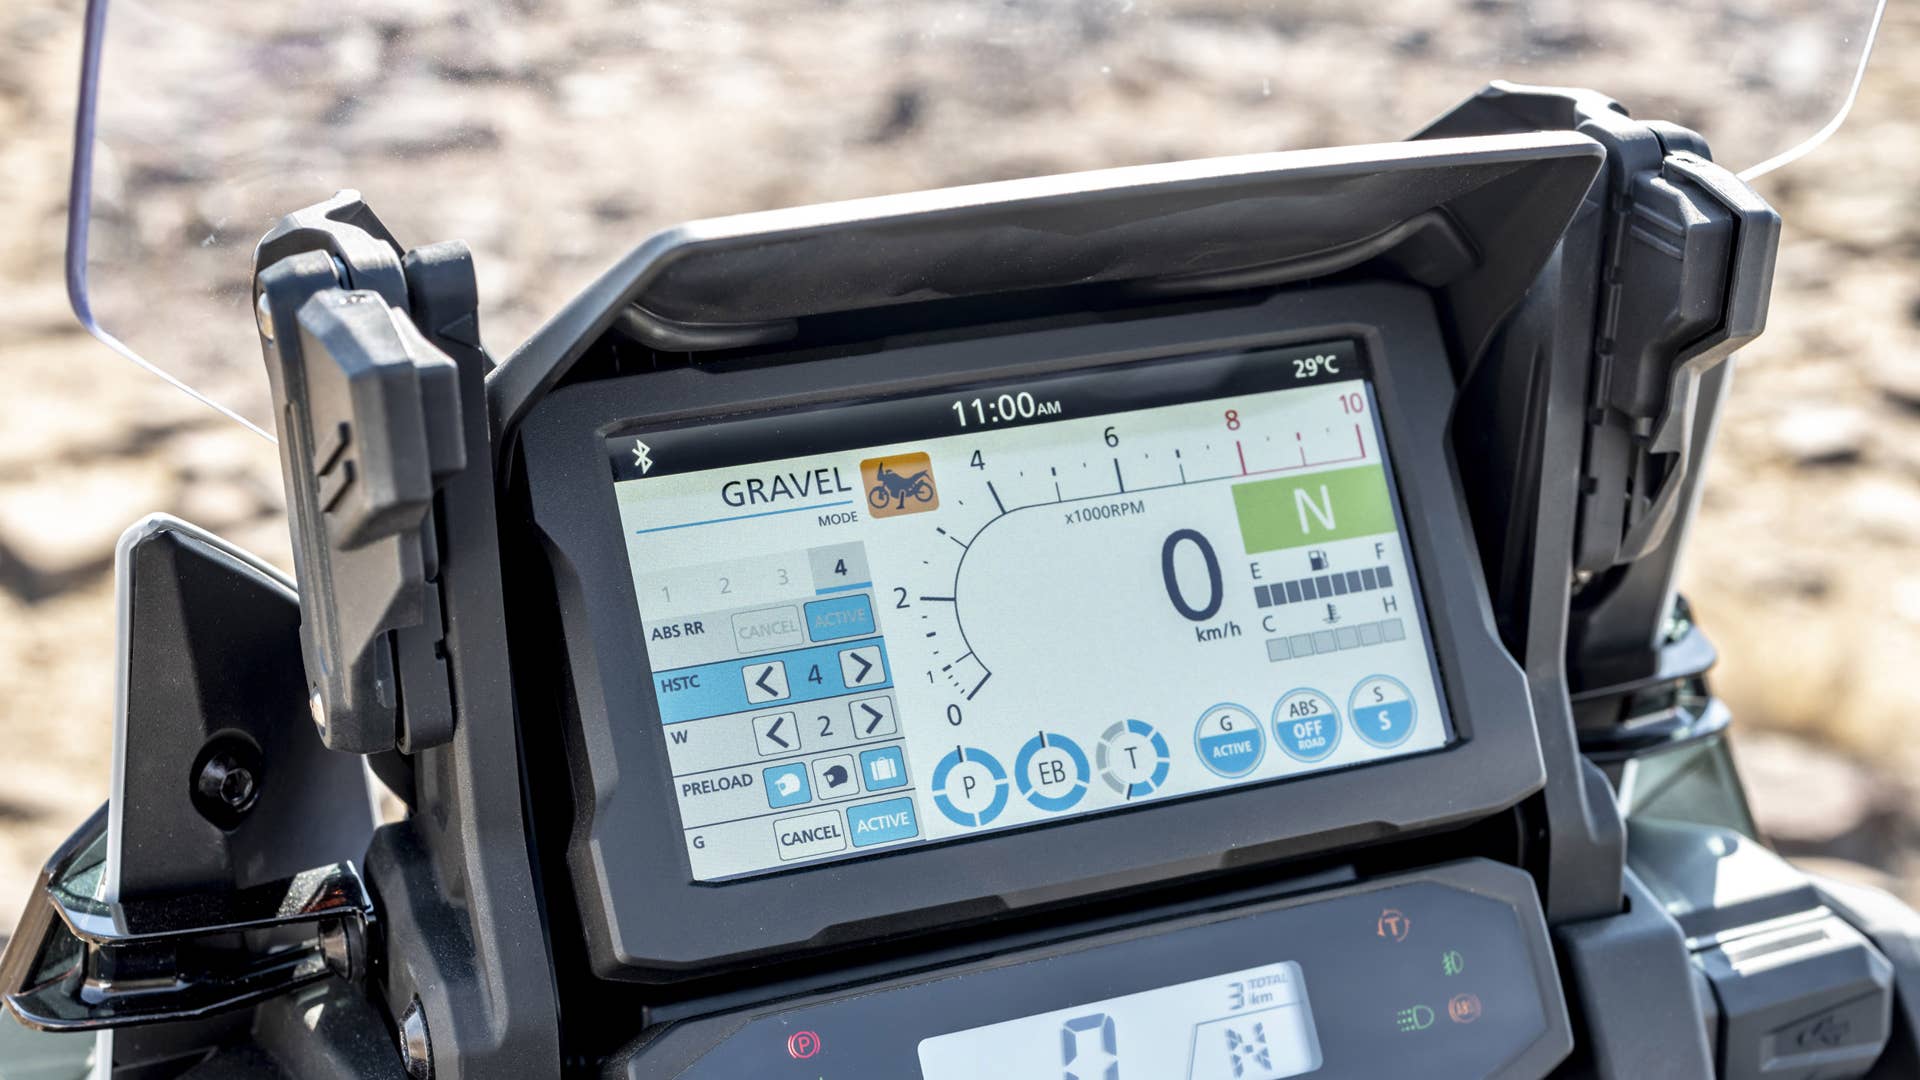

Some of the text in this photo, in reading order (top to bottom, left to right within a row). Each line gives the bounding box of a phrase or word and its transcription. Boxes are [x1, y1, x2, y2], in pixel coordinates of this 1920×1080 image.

[1293, 355, 1340, 379] 29°C
[1339, 392, 1364, 415] 10
[1225, 409, 1241, 431] 8
[1104, 426, 1119, 448] 6
[970, 449, 985, 471] 4
[721, 467, 852, 508] GRAVEL
[818, 511, 859, 527] MODE
[1065, 500, 1145, 525] x1000RPM
[1293, 484, 1336, 535] N
[1375, 543, 1385, 560] F
[662, 558, 848, 603] 1 2 3 4
[1162, 529, 1223, 622] 0
[1250, 562, 1262, 580] E
[893, 586, 911, 609] 2
[1383, 595, 1398, 613] H
[814, 608, 866, 629] ACTIVE
[1262, 615, 1277, 633] C
[651, 621, 705, 641] ABS RR
[738, 619, 799, 641] CANCEL
[1195, 621, 1242, 643] km/h
[661, 675, 700, 693] HSTC
[808, 664, 823, 685] 4
[927, 671, 935, 684] 1
[1373, 686, 1384, 702] S
[947, 704, 963, 726] 0
[1289, 699, 1319, 718] ABS
[817, 715, 834, 737] 2
[1220, 715, 1233, 732] G
[1293, 720, 1323, 739] OFF
[1378, 710, 1392, 731] S
[671, 729, 688, 745] W
[1298, 736, 1326, 750] ROAD
[1124, 747, 1138, 770] T
[1213, 740, 1253, 759] ACTIVE
[1038, 760, 1066, 785] EB
[682, 773, 753, 797] PRELOAD
[963, 776, 976, 799] P
[856, 811, 911, 834] ACTIVE
[693, 836, 706, 850] G
[781, 824, 841, 847] CANCEL
[1248, 973, 1288, 989] TOTAL
[1228, 982, 1245, 1010] 3
[1249, 992, 1273, 1004] km
